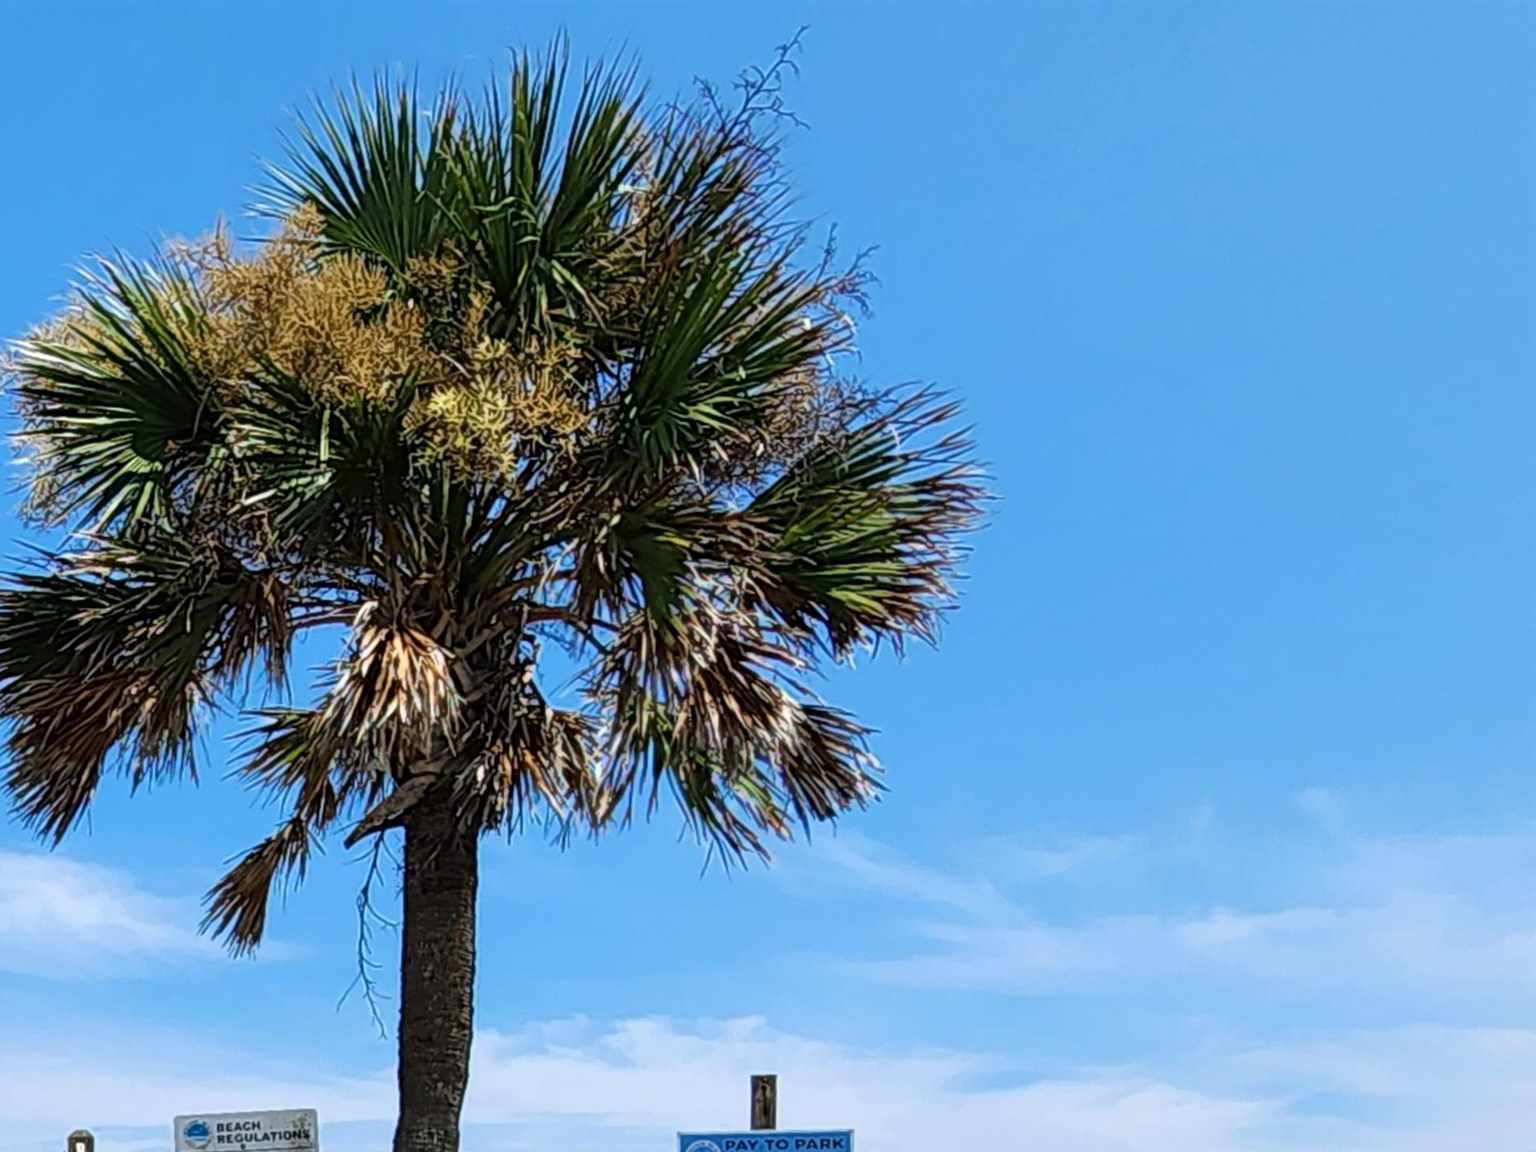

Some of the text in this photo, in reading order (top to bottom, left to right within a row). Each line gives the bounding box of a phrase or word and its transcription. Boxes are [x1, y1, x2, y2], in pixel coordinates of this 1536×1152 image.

[216, 1121, 261, 1132] BEACH
[216, 1129, 311, 1144] REGULATIONS
[725, 1138, 843, 1151] PAY TO PARK
